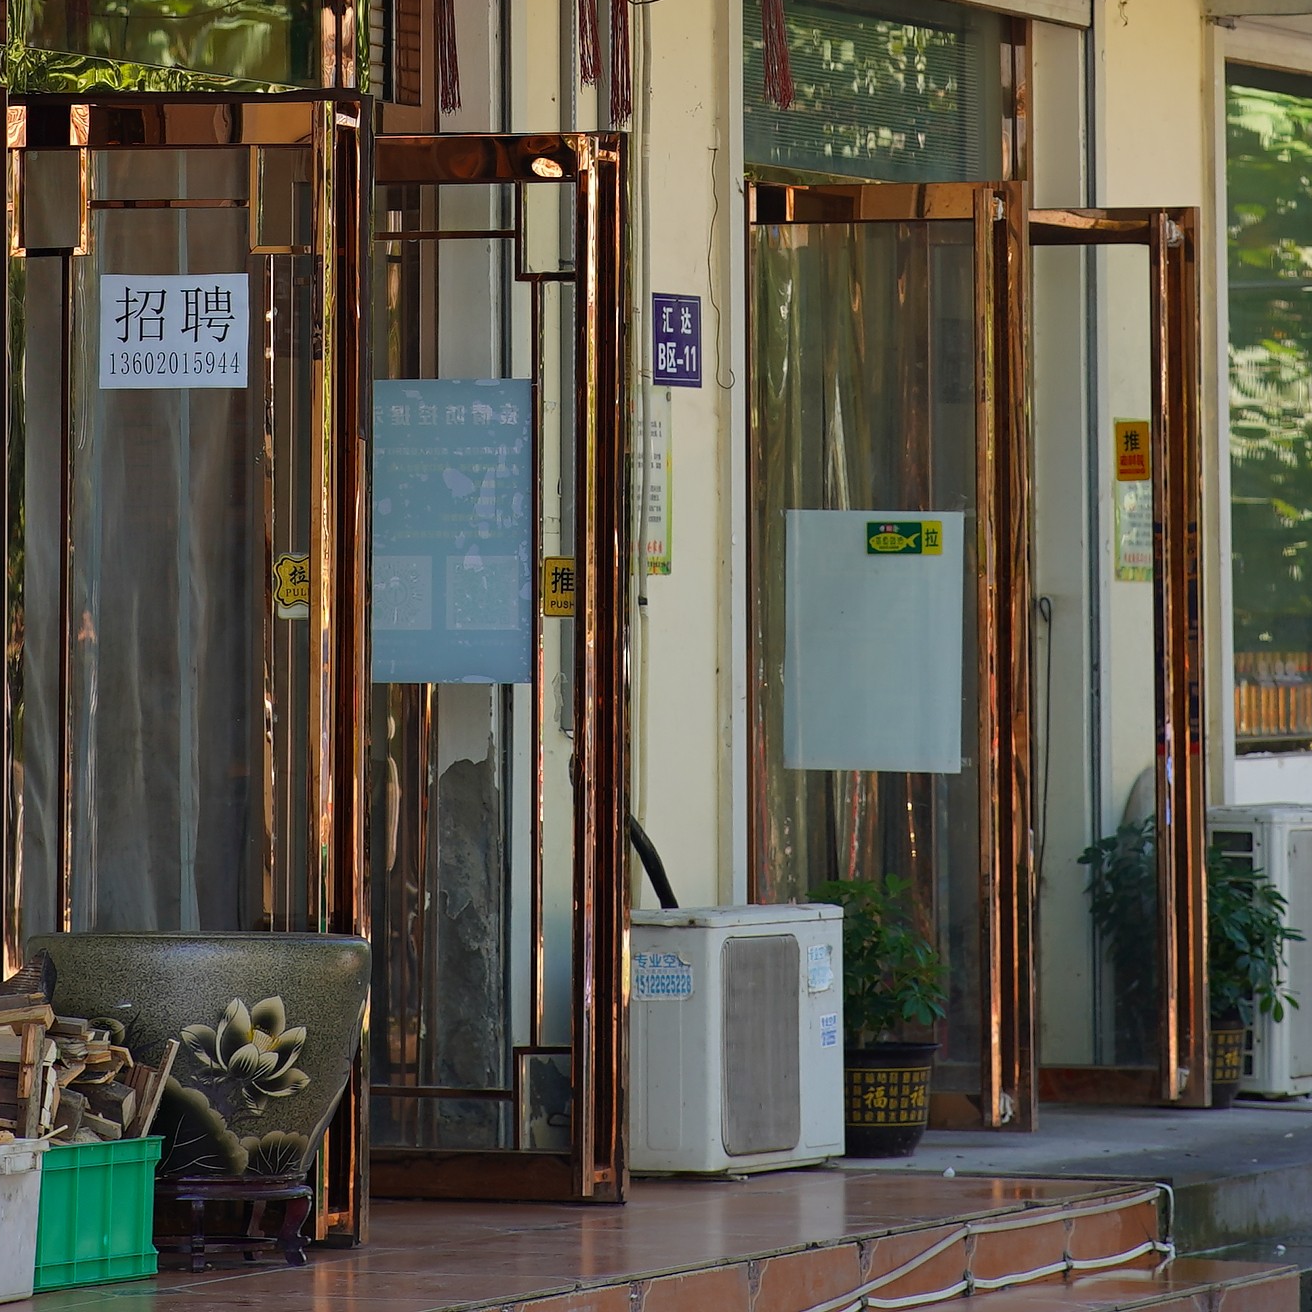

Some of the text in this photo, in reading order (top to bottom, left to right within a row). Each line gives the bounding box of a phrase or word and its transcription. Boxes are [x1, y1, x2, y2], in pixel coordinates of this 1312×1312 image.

[114, 285, 236, 344] 招聘
[661, 306, 693, 336] 汇达
[109, 350, 240, 376] 13602015944
[657, 340, 697, 373] B区-11
[1123, 429, 1141, 452] 推
[924, 527, 939, 548] 拉
[288, 565, 309, 586] 拉
[551, 566, 574, 594] 推
[633, 952, 689, 969] 专业空
